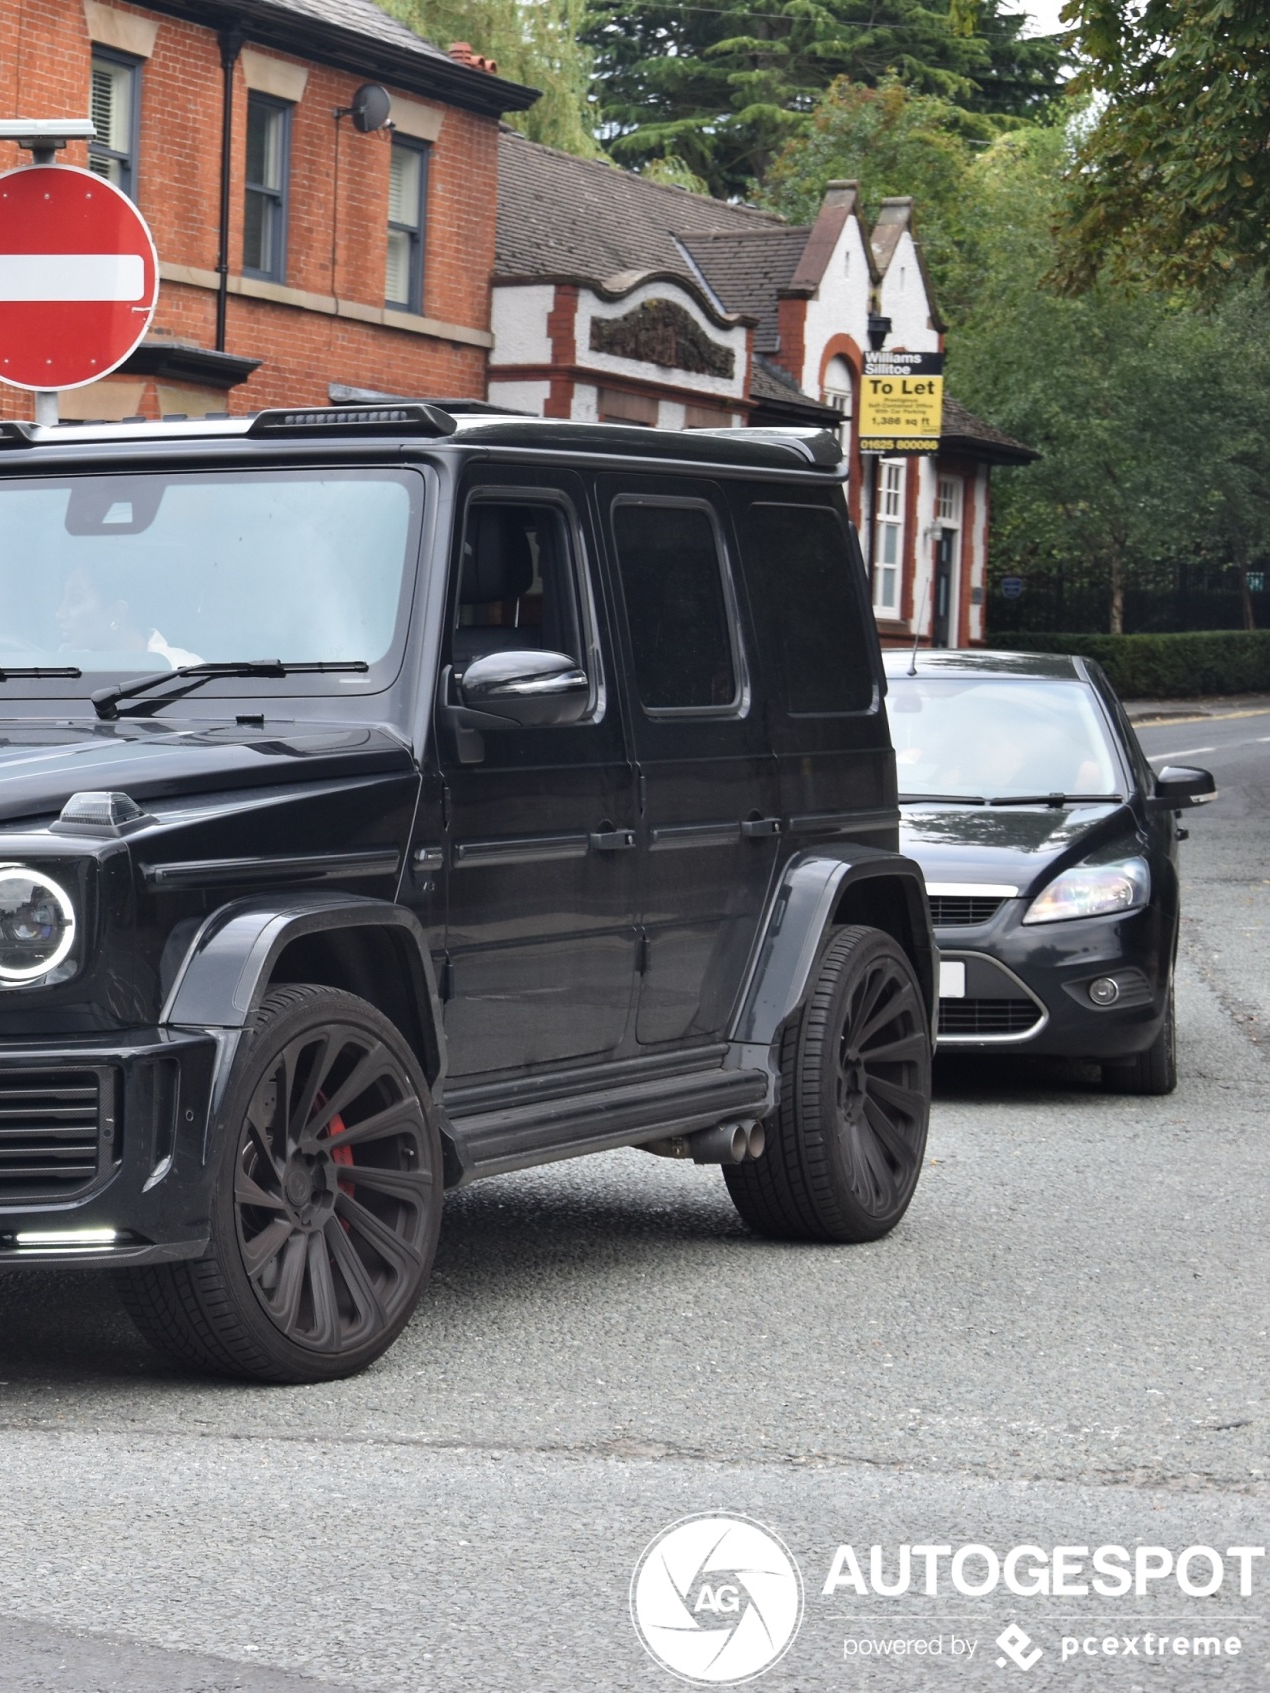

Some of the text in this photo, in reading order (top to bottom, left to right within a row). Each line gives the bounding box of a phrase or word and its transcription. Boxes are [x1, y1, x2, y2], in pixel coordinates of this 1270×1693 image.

[865, 352, 922, 364] Williams
[865, 363, 911, 375] Sillitoe
[869, 380, 935, 395] To Let
[921, 417, 930, 426] ft
[860, 440, 895, 450] 01625
